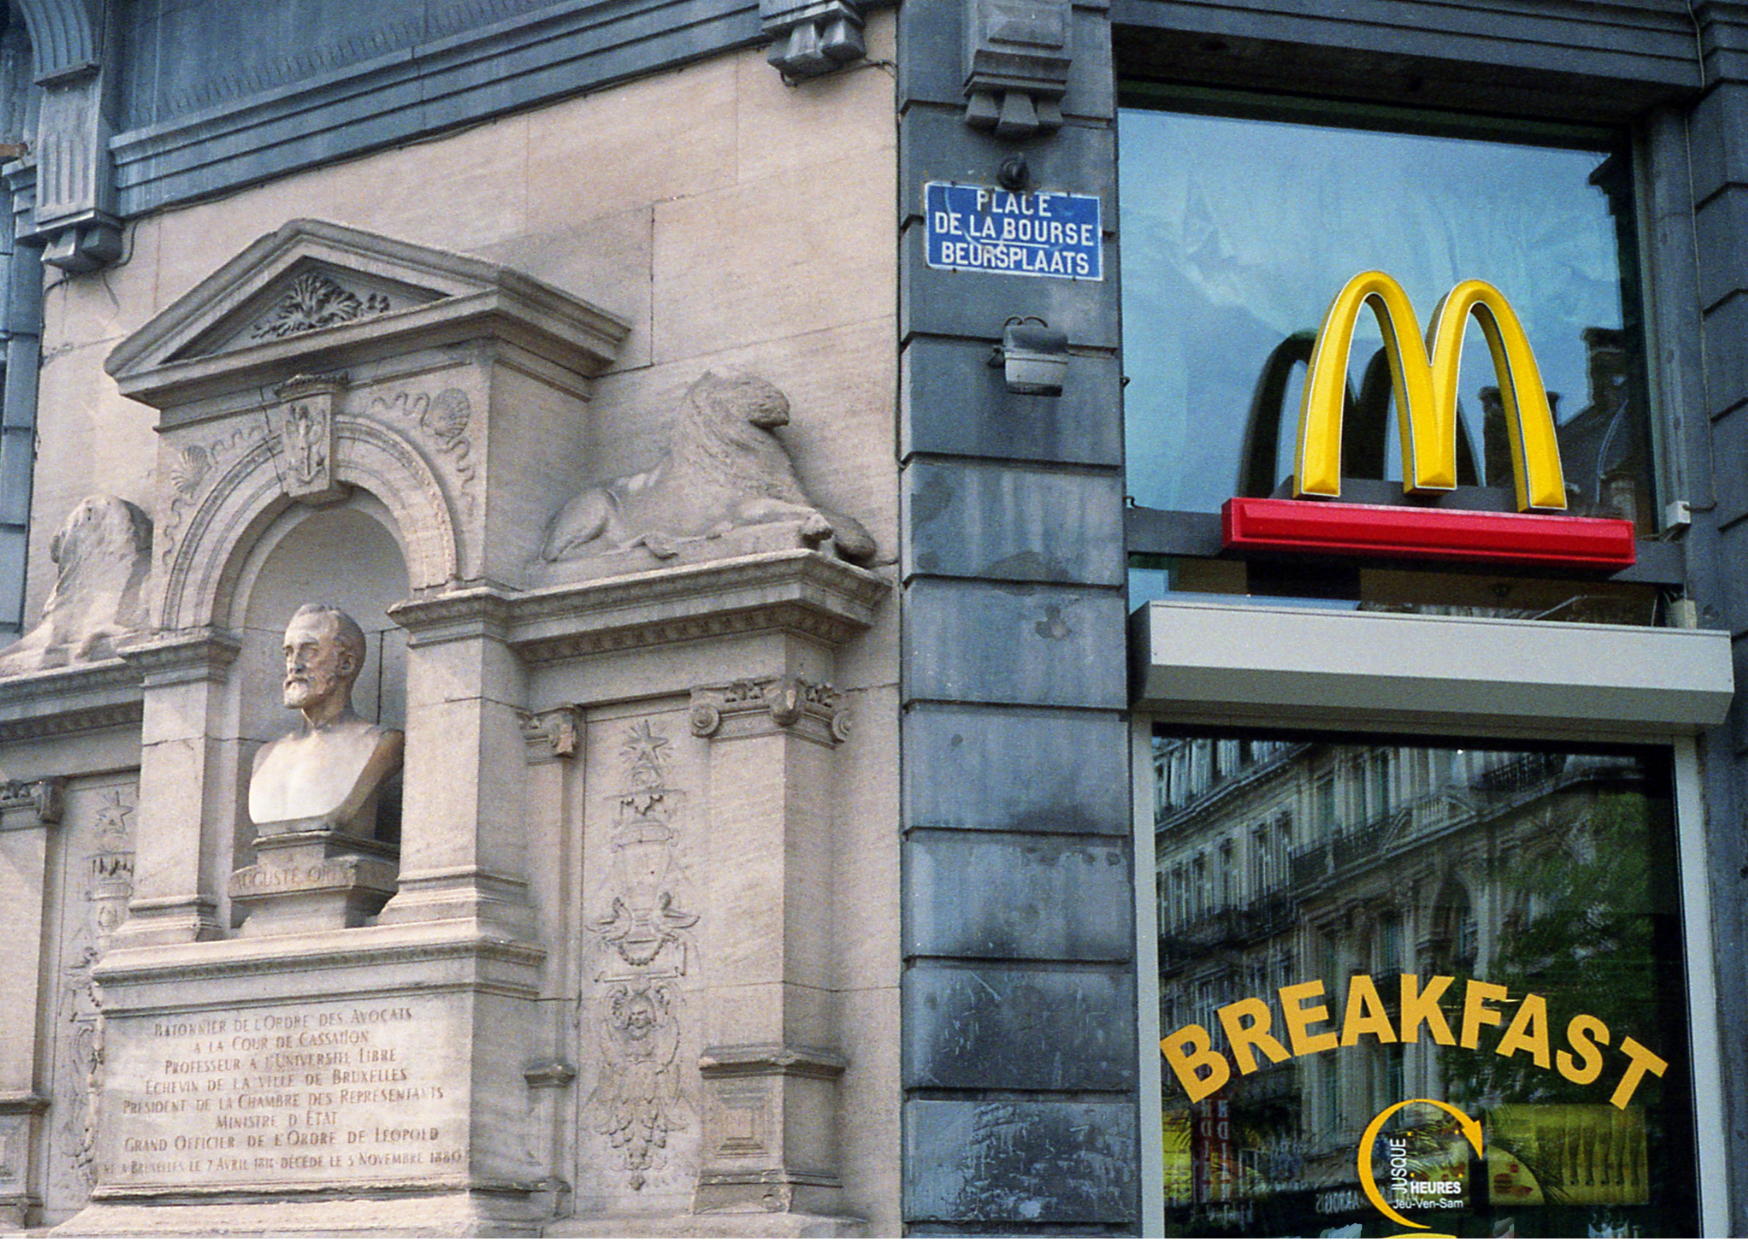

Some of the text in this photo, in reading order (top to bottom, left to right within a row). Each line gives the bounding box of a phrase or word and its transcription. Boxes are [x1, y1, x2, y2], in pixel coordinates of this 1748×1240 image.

[976, 190, 1052, 217] PLACE
[935, 211, 1094, 246] DE LA BOURSE
[941, 241, 1090, 275] BEURSPLAATS
[234, 1018, 249, 1032] DE
[319, 1012, 343, 1027] DES
[209, 1041, 224, 1053] LA
[232, 1036, 269, 1051] COUR
[276, 1035, 293, 1049] DE
[299, 1030, 369, 1048] CASSATION
[1159, 973, 1669, 1111] BREAKFAST
[165, 1058, 241, 1075] PROFESSEUR
[359, 1048, 397, 1063] LIBRE
[207, 1078, 223, 1092] DE
[233, 1076, 250, 1090] LA
[259, 1073, 295, 1088] VILLE
[305, 1072, 322, 1087] DE
[332, 1068, 408, 1086] BRUXELLES
[196, 1098, 211, 1112] DE
[219, 1097, 233, 1111] LA
[238, 1093, 300, 1109] CHAMBRE
[308, 1092, 333, 1106] DES
[216, 1115, 276, 1130] MINISTRE
[125, 1136, 168, 1152] GRAND
[174, 1135, 236, 1151] OFFICIER
[247, 1135, 265, 1148] DE
[348, 1130, 367, 1144] DE
[189, 1160, 202, 1172] LE
[215, 1157, 249, 1172] AVRIL
[330, 1155, 343, 1168] LE
[359, 1152, 424, 1167] NOVEMBRE
[1389, 1138, 1408, 1194] JUSQUE
[1410, 1181, 1462, 1195] HEURES
[1392, 1197, 1464, 1209] Jeu-Ven-Sam
